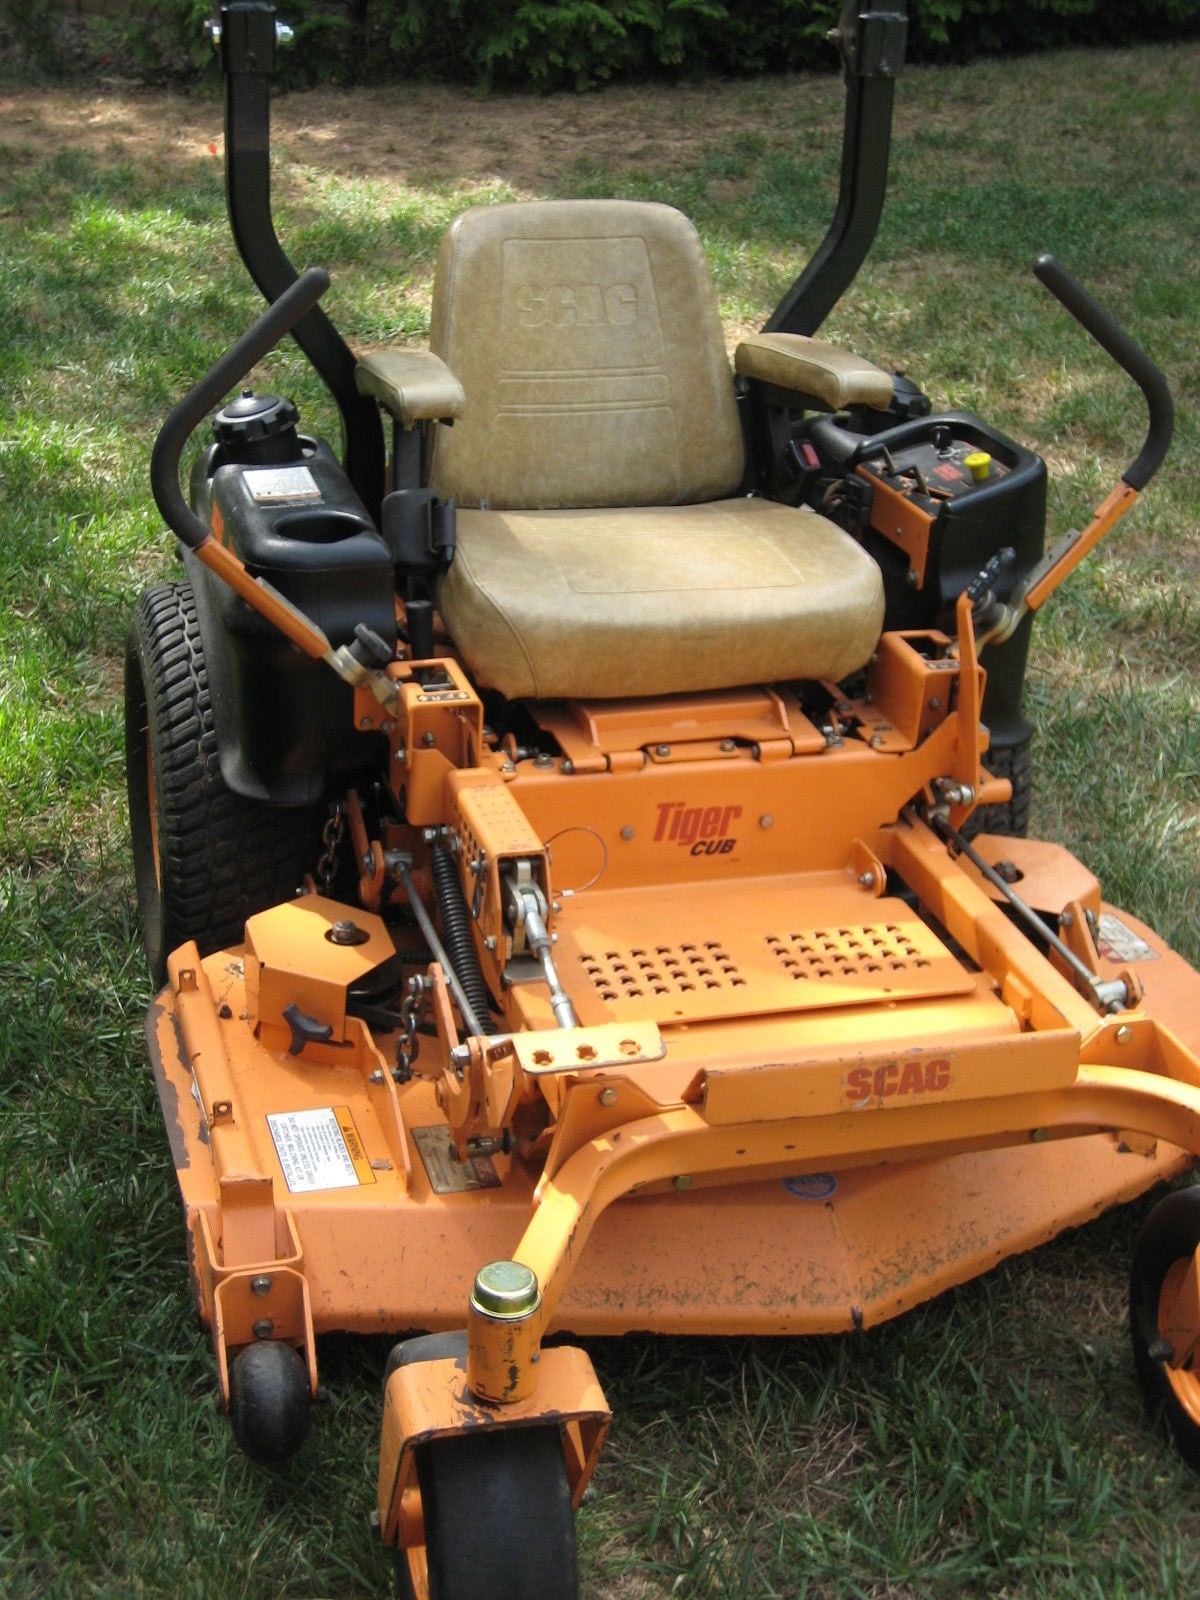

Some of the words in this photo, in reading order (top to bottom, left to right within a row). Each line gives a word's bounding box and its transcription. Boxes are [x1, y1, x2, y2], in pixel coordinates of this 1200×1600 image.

[653, 801, 743, 846] Tiger
[690, 838, 737, 856] CUB
[846, 1059, 951, 1100] SCAG
[344, 1132, 363, 1160] WARNING
